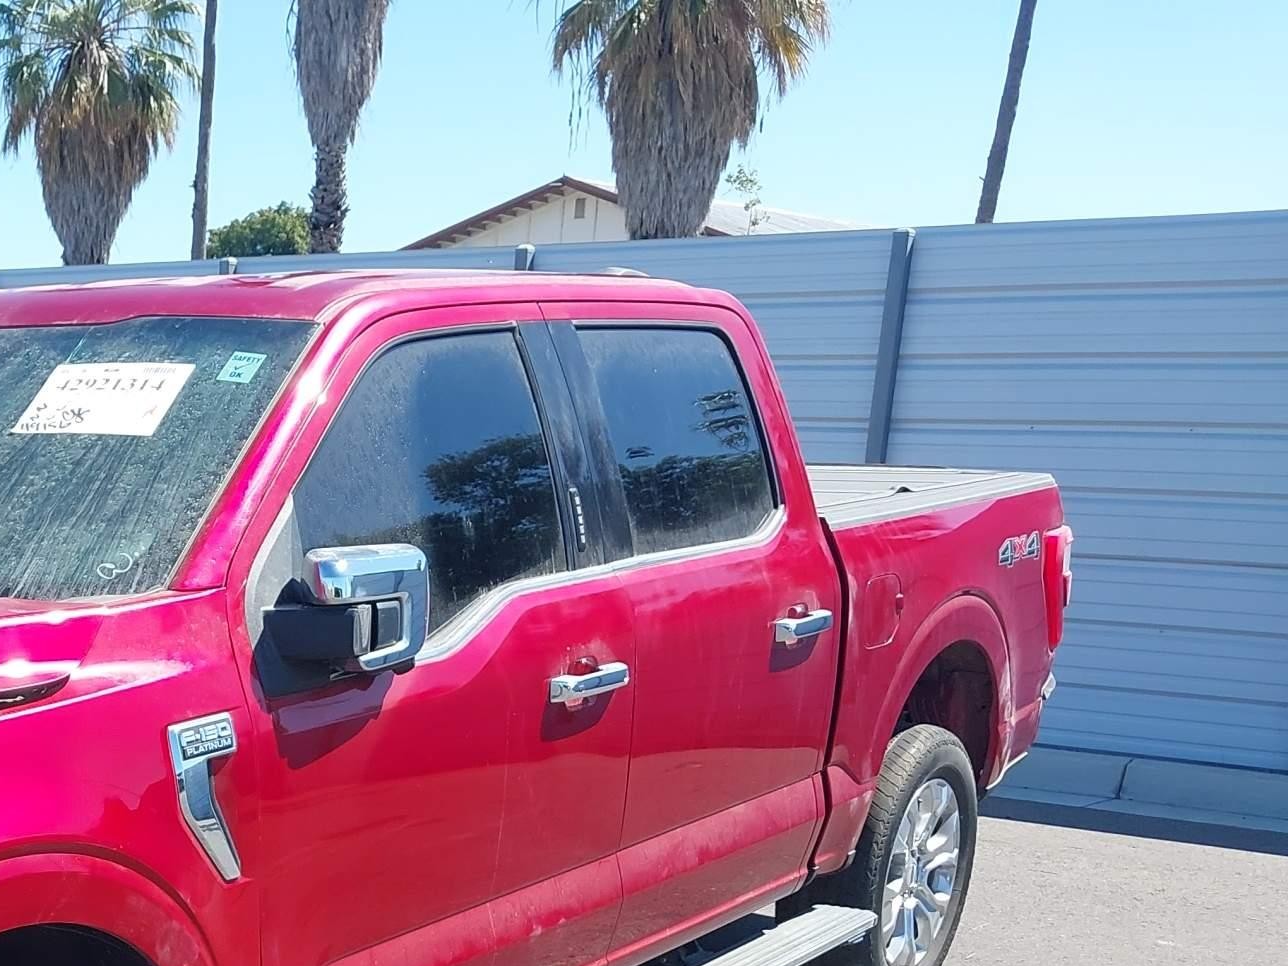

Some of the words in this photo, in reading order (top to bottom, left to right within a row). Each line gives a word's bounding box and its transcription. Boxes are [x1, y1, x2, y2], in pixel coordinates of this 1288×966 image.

[232, 354, 263, 364] SAFETY
[55, 378, 167, 391] 42921314
[180, 722, 232, 747] F-150
[185, 737, 233, 758] PLATINUM
